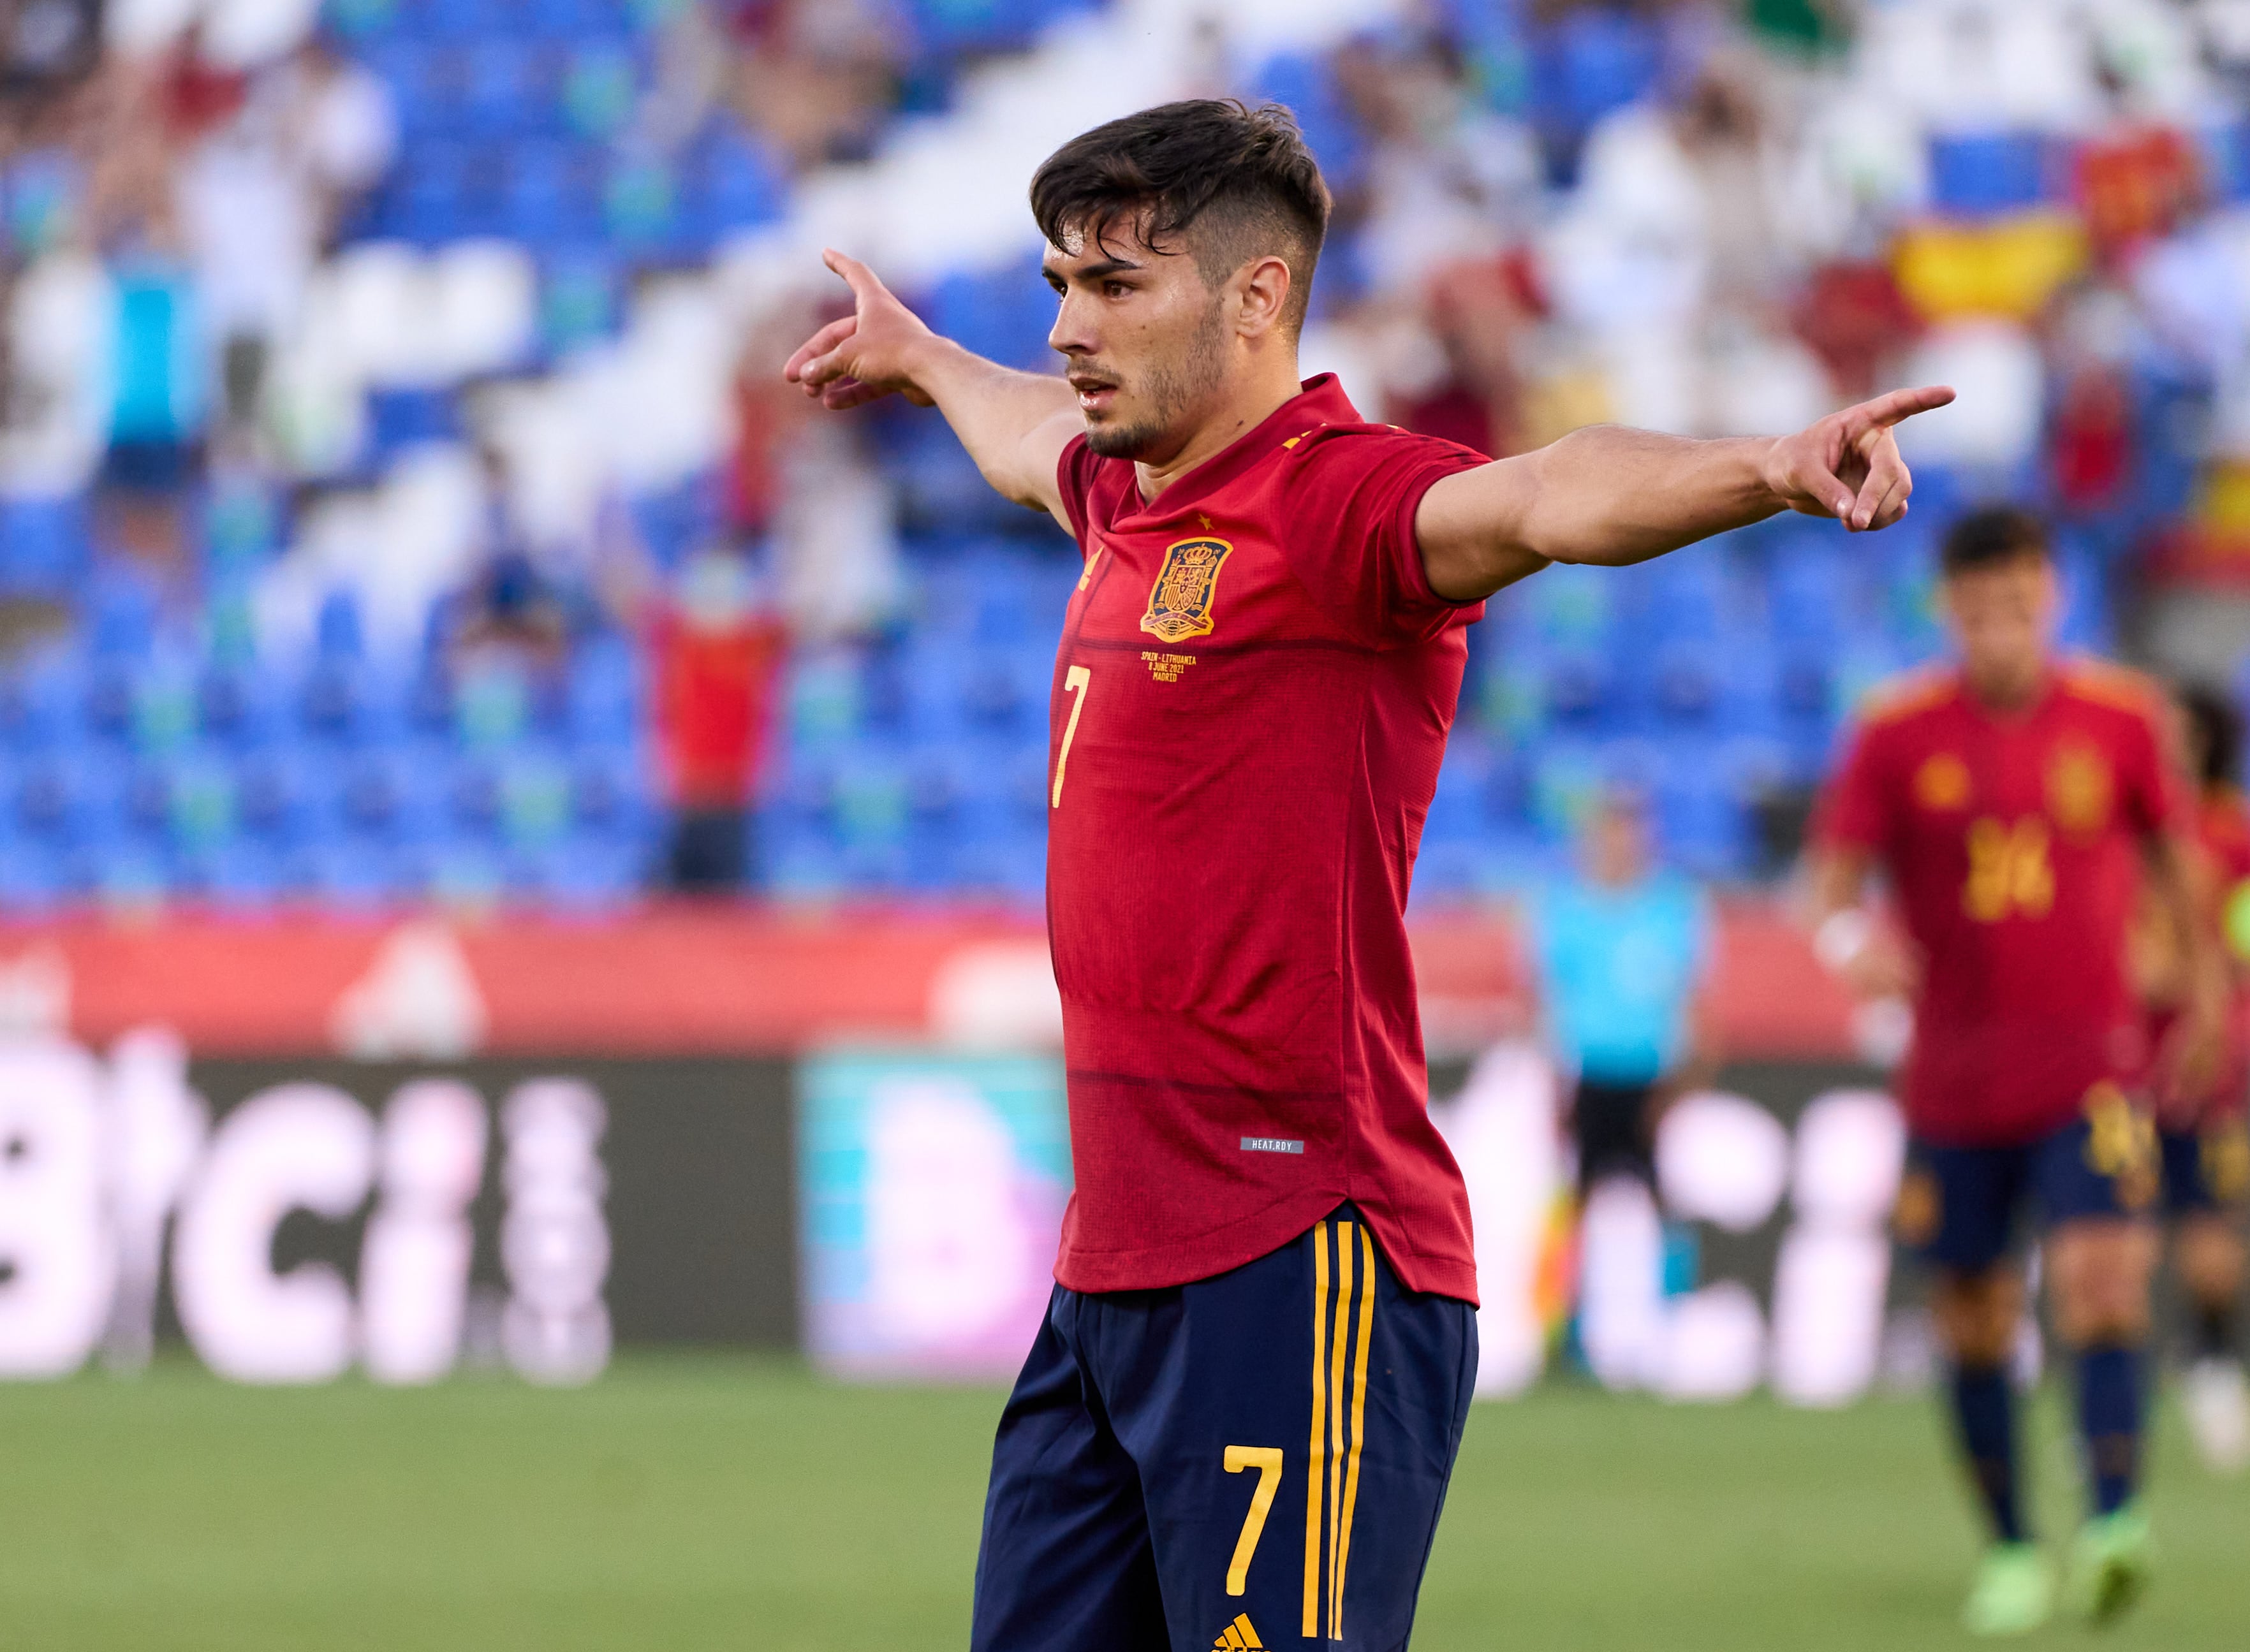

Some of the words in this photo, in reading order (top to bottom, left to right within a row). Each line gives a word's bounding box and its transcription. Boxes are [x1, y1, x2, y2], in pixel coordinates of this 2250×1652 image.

[1141, 651, 1158, 661] SPAIN
[1161, 654, 1196, 665] LITHUANIA
[1153, 662, 1169, 672] JUNE
[1169, 664, 1184, 674] 2021
[1152, 671, 1177, 682] MADRID
[1052, 665, 1091, 808] 7
[1252, 1139, 1292, 1151] HEAT.RDY
[1223, 1445, 1283, 1596] 7
